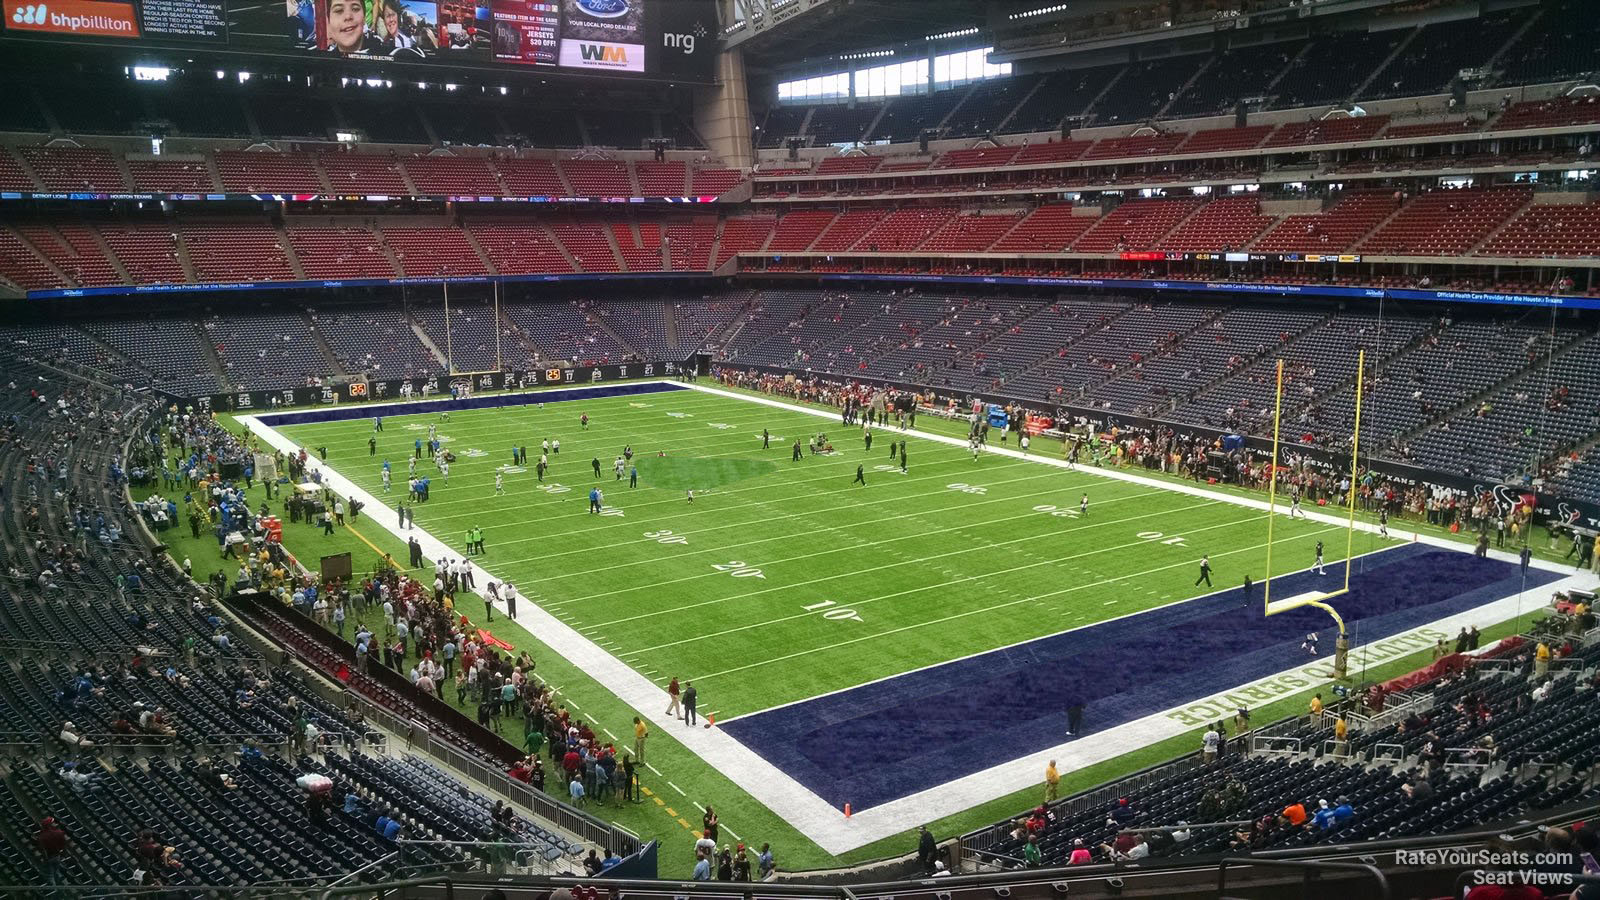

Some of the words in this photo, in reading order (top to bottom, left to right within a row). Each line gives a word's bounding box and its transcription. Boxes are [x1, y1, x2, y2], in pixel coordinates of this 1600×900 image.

[51, 12, 132, 31] bhpbilliton
[527, 31, 554, 39] JERSEYS
[530, 38, 543, 46] $20
[663, 32, 695, 55] nrg
[580, 44, 627, 63] WM
[566, 372, 575, 381] 17
[645, 366, 654, 375] 27
[238, 397, 252, 406] 56
[321, 389, 334, 399] 76
[643, 529, 687, 544] 30
[1136, 531, 1186, 546] 10
[710, 560, 763, 578] 20
[800, 599, 858, 620] 10
[1166, 675, 1311, 727] SERVICE
